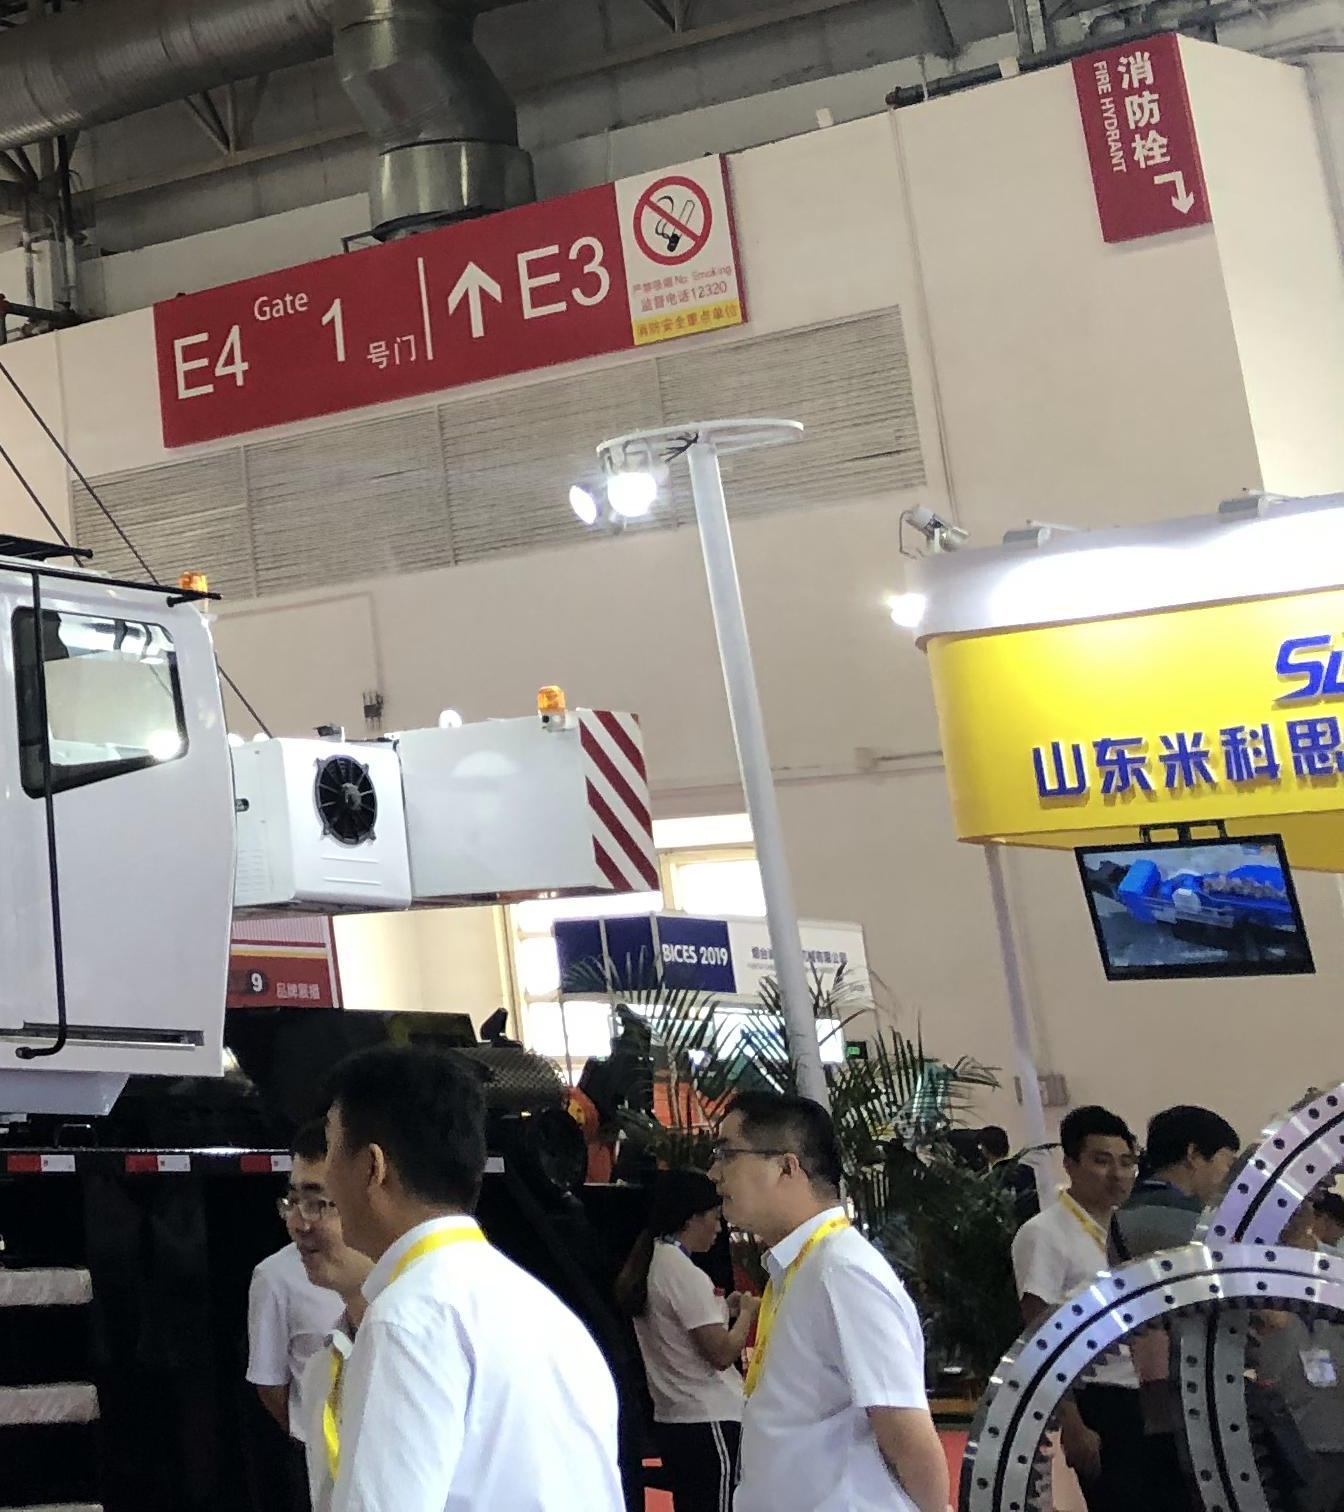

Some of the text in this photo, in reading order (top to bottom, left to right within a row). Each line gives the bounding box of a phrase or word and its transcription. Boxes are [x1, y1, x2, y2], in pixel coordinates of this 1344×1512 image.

[1093, 60, 1127, 174] FIRE HYDRANT
[1116, 51, 1171, 169] 消防栓
[173, 236, 610, 399] E4 Gate 1 号门 E3
[1032, 716, 1344, 798] 山东米科思
[662, 944, 728, 966] BICES 2019
